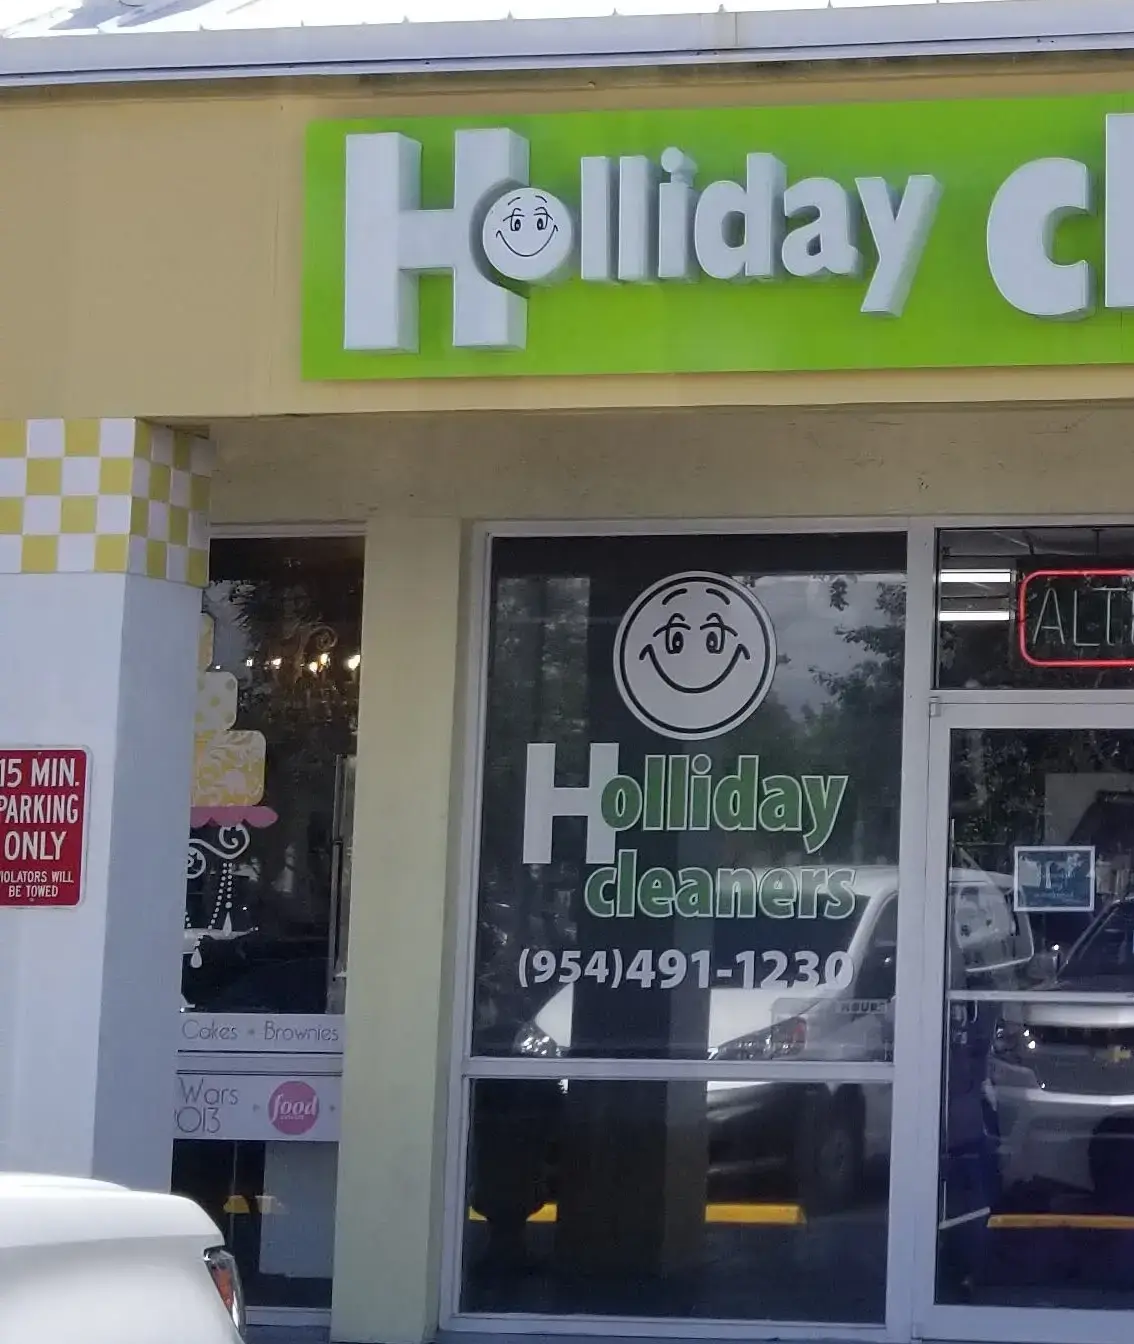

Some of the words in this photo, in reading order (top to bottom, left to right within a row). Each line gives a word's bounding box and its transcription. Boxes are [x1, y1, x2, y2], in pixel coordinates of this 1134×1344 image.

[343, 127, 942, 352] Holliday
[30, 758, 80, 787] MIN.
[522, 743, 849, 864] Holliday
[4, 830, 67, 861] ONLY
[0, 870, 48, 883] IOLATORS
[51, 871, 74, 884] WILL
[8, 885, 22, 898] BE
[25, 886, 59, 898] TOWED
[584, 849, 857, 919] cleaners
[518, 949, 854, 990] (954)491-1230
[182, 1019, 239, 1041] Cakes
[264, 1020, 340, 1042] Brownies
[178, 1077, 239, 1106] Wars
[174, 1106, 222, 1134] 013
[269, 1093, 318, 1126] food
